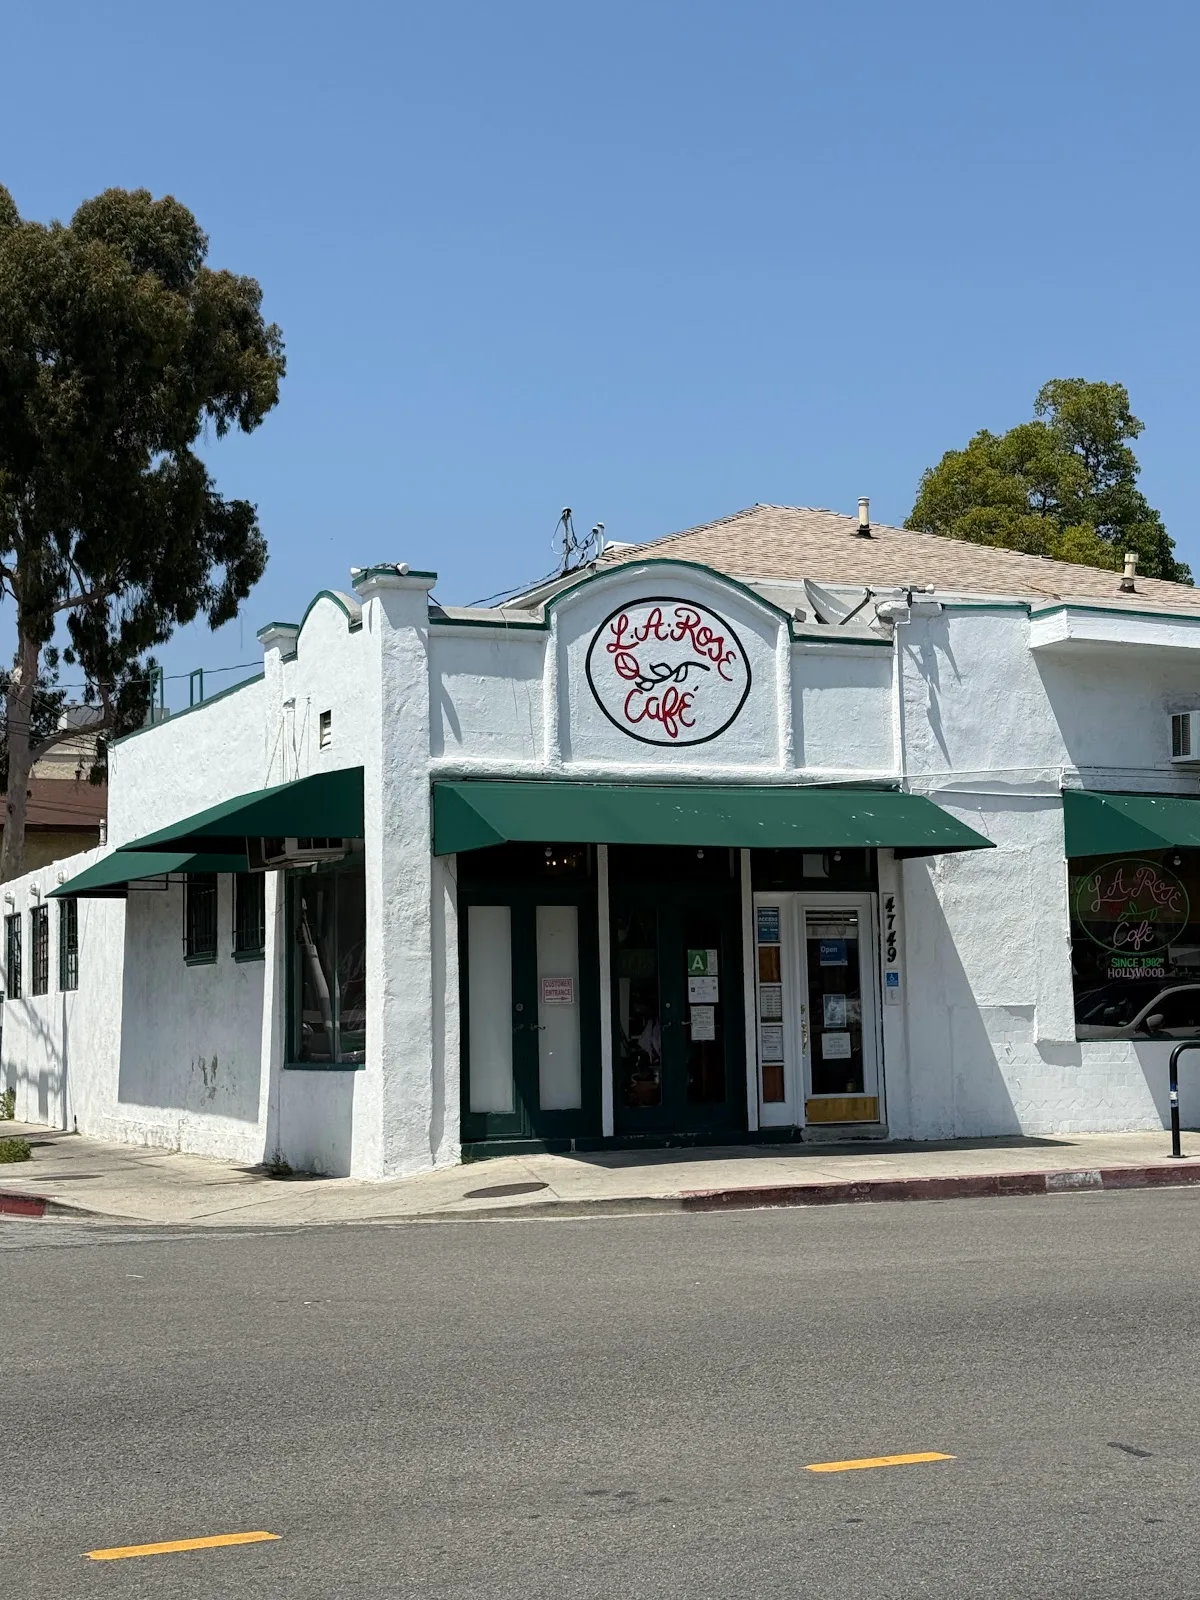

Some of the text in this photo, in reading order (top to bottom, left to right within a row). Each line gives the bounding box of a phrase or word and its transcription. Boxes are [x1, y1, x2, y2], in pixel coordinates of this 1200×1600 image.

[885, 896, 897, 963] 4749
[820, 945, 838, 955] Open
[691, 954, 705, 970] A
[1111, 957, 1139, 968] SINCE
[1107, 967, 1165, 979] HOLLYWOOD
[543, 980, 572, 988] CUSTOMER
[545, 988, 571, 997] ENTRANCE
